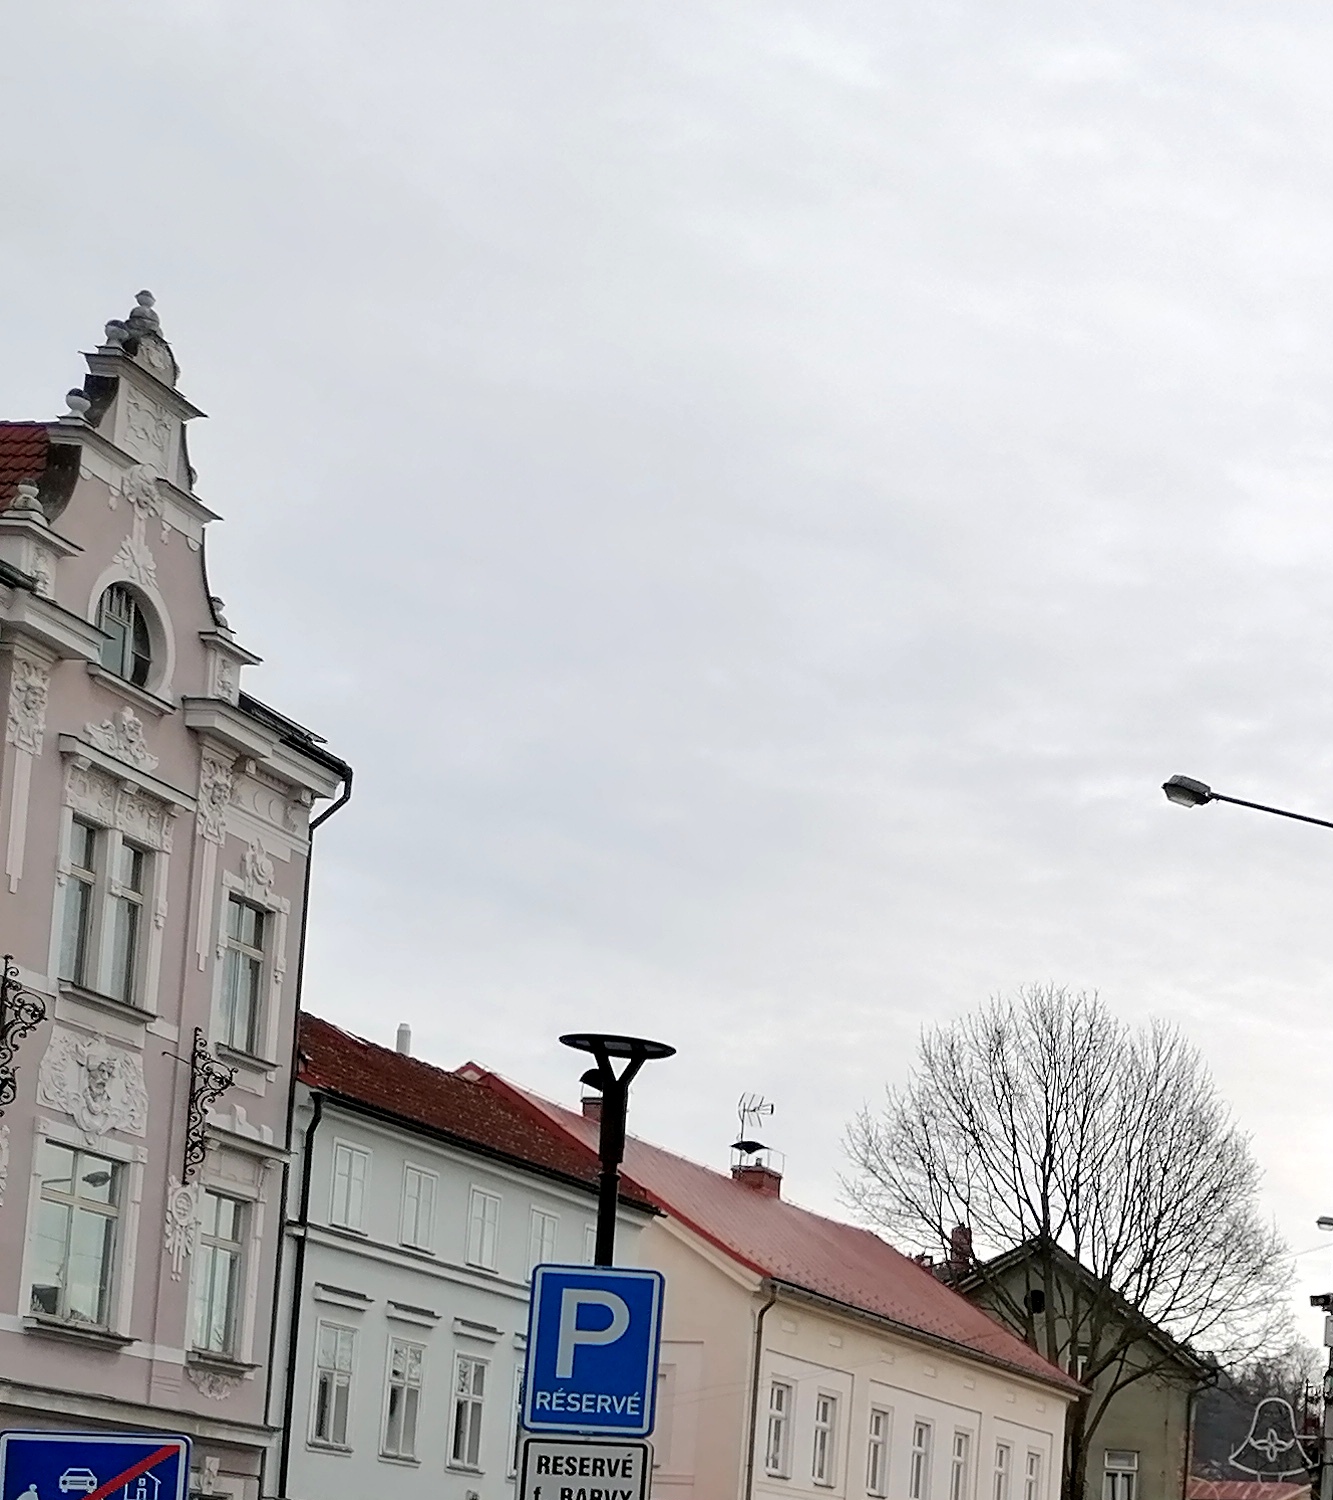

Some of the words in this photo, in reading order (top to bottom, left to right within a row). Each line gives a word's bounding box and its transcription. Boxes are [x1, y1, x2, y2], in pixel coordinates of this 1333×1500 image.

[555, 1287, 631, 1379] P
[535, 1387, 641, 1416] RÉSERVÉ
[536, 1453, 634, 1479] RESERVÉ
